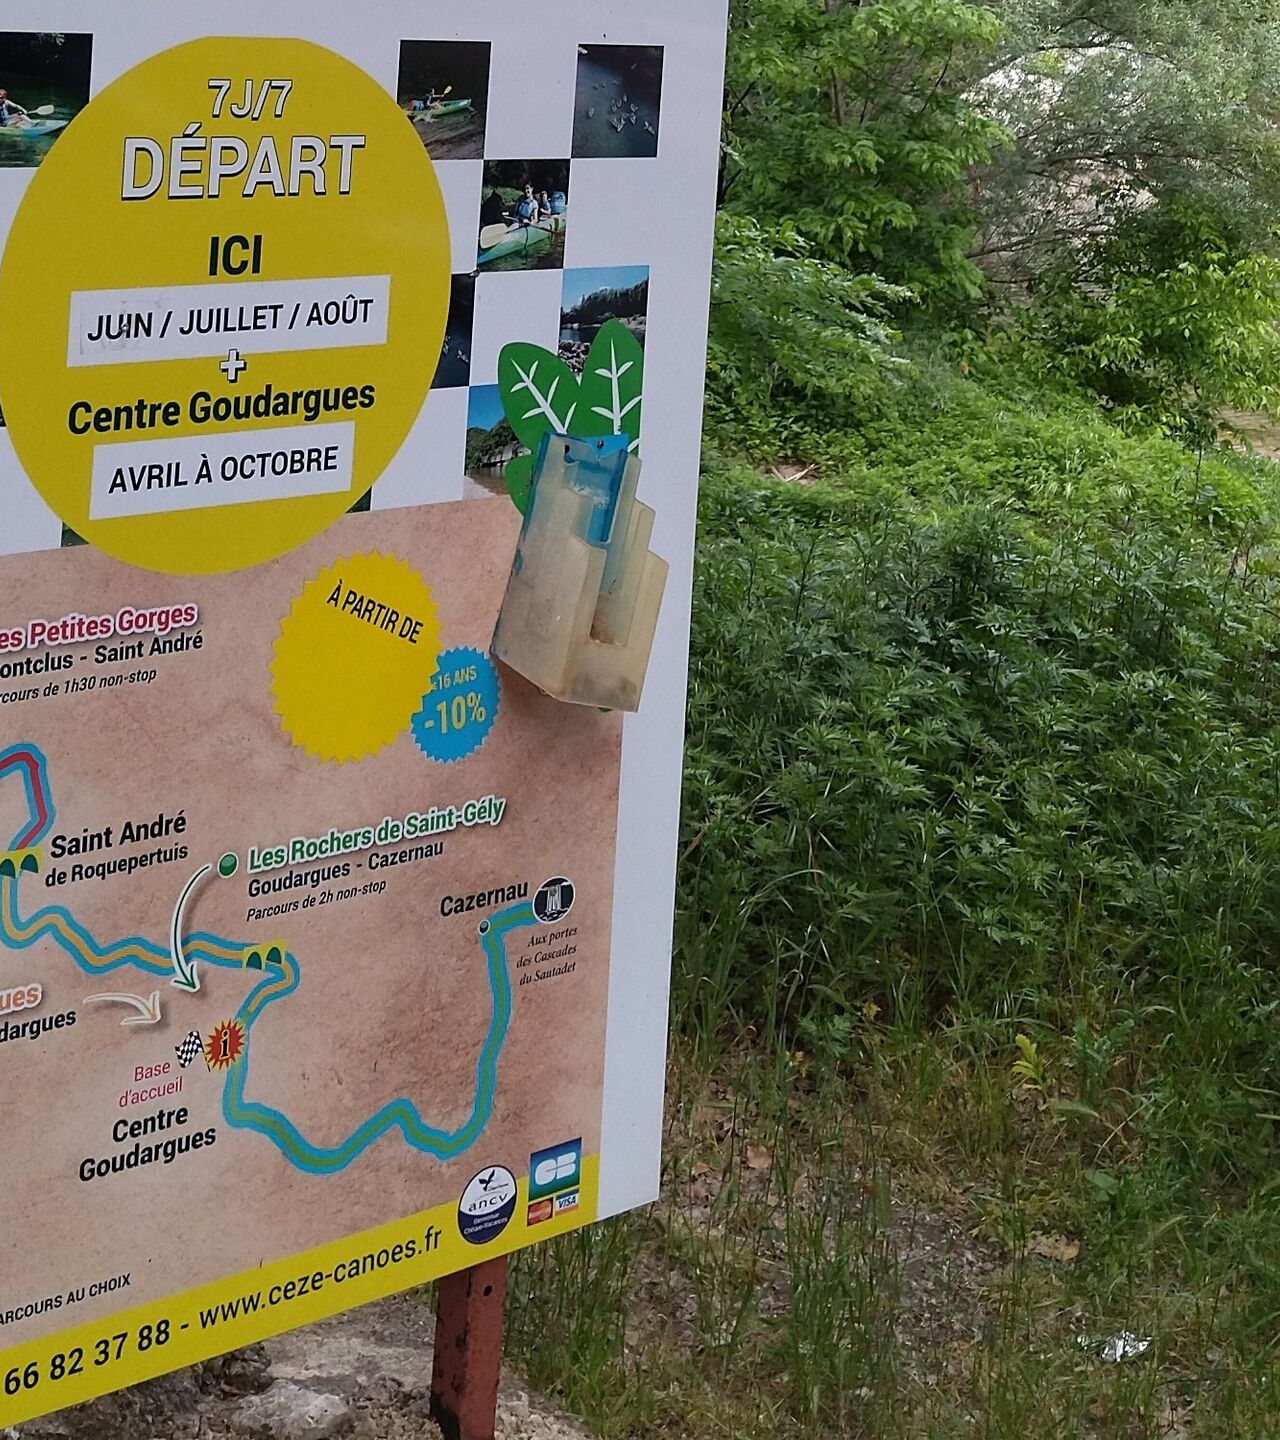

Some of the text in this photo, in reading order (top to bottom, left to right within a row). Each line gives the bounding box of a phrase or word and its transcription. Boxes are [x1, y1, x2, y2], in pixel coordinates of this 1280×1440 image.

[209, 79, 292, 118] 7J/7
[120, 122, 365, 200] DÉPART
[209, 235, 262, 276] ICI
[87, 312, 153, 341] JUIN
[179, 304, 283, 335] JUILLET
[306, 294, 374, 326] AOÛT
[68, 384, 376, 435] Centre Goudargues
[108, 446, 339, 494] AVRIL À OCTOBRE
[31, 614, 111, 645] Petites
[120, 604, 196, 638] Gorges
[326, 579, 424, 644] À PARTIR DE
[95, 641, 144, 664] Saint
[150, 632, 203, 656] André
[44, 682, 59, 697] de
[64, 676, 95, 693] 1h30
[99, 668, 157, 687] non-stop
[453, 665, 477, 687] ANS
[424, 691, 487, 736] -10%
[50, 811, 187, 858] Saint André
[249, 796, 505, 871] Les Rochers de Saint-Gély
[45, 844, 188, 887] de Roquepertuis
[248, 861, 350, 898] Goudargues
[368, 840, 443, 870] Cazernau
[247, 880, 386, 922] Parcours de 2h non-stop
[440, 883, 528, 918] Cazernau
[516, 944, 576, 968] des Cascades
[528, 928, 577, 947] Aux portes
[520, 962, 576, 986] du Sautadet
[119, 1077, 183, 1107] d'accueil
[134, 1062, 171, 1082] Base
[112, 1106, 188, 1143] Centre
[78, 1129, 217, 1182] Goudargues
[469, 1193, 507, 1211] ancv
[558, 1195, 576, 1209] VISA
[67, 1289, 85, 1305] AU
[89, 1273, 131, 1299] CHOIX
[4, 1363, 39, 1395] 66
[51, 1350, 83, 1380] 82
[94, 1334, 126, 1366] 37
[137, 1320, 170, 1352] 88
[199, 1225, 443, 1330] www.ceze-canoes.fr
